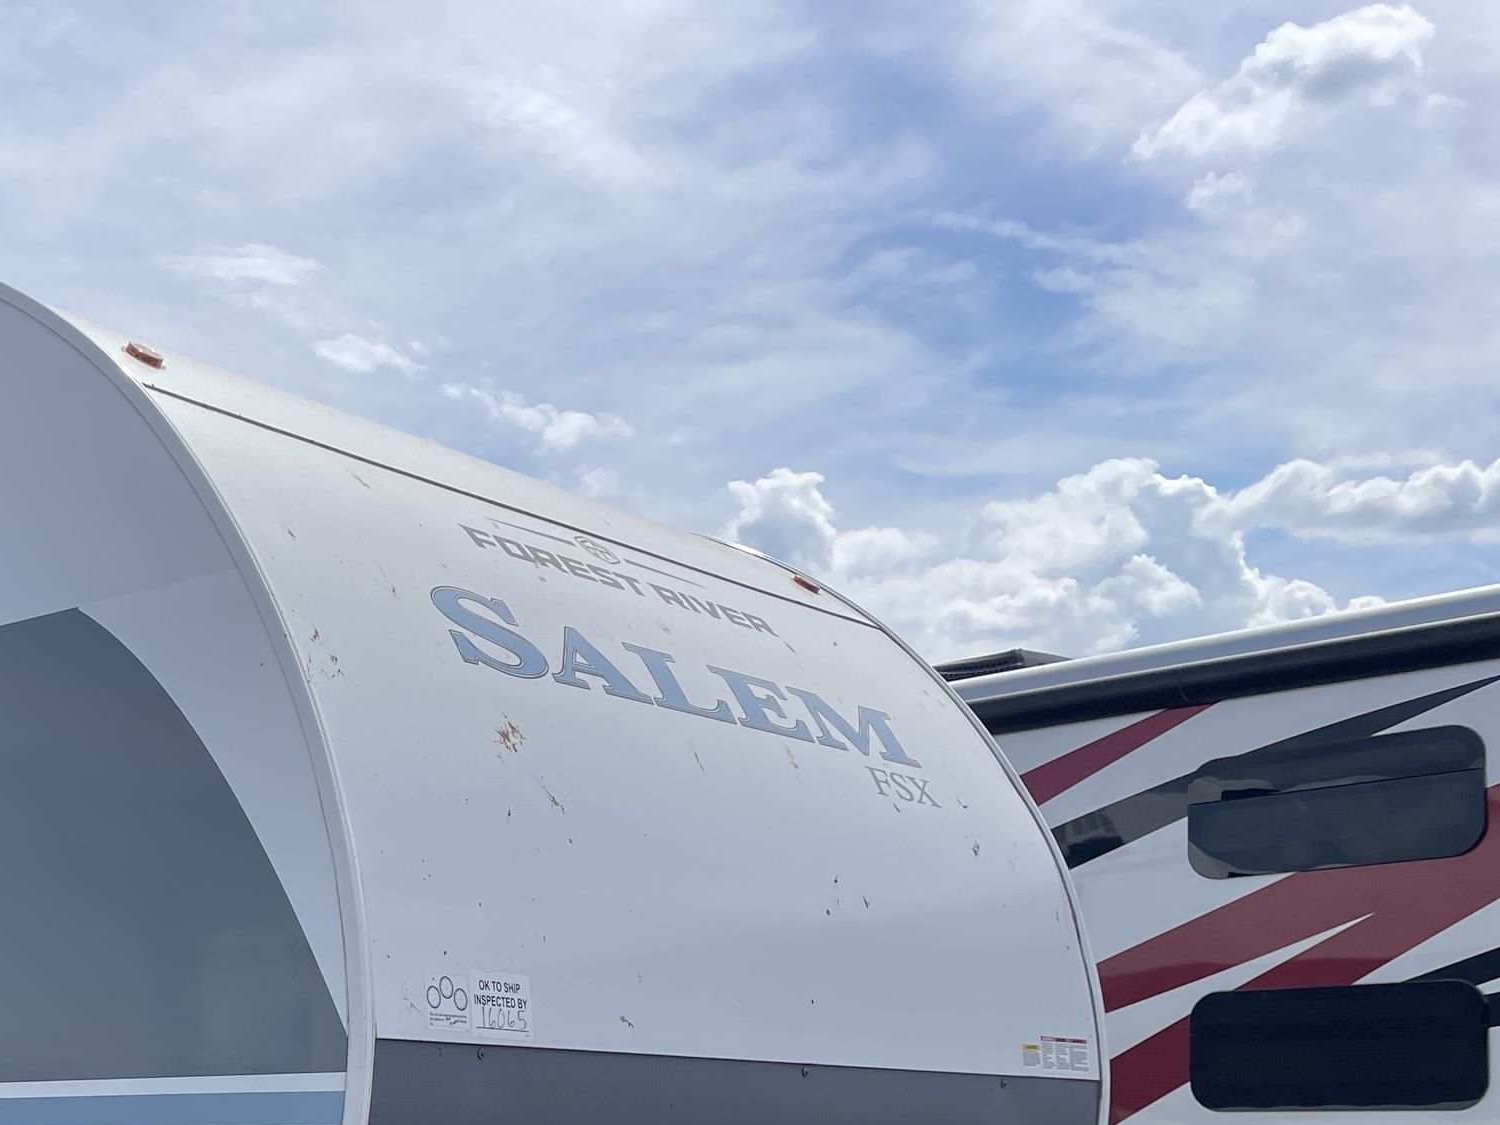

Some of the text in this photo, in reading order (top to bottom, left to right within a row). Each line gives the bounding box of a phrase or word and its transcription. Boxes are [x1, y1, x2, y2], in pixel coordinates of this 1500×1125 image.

[458, 524, 781, 638] FOREST RIVER
[429, 585, 924, 770] SALEM
[865, 764, 943, 809] FSX
[474, 994, 527, 1009] INSPECTED BY
[478, 979, 520, 994] OK TO SHIP
